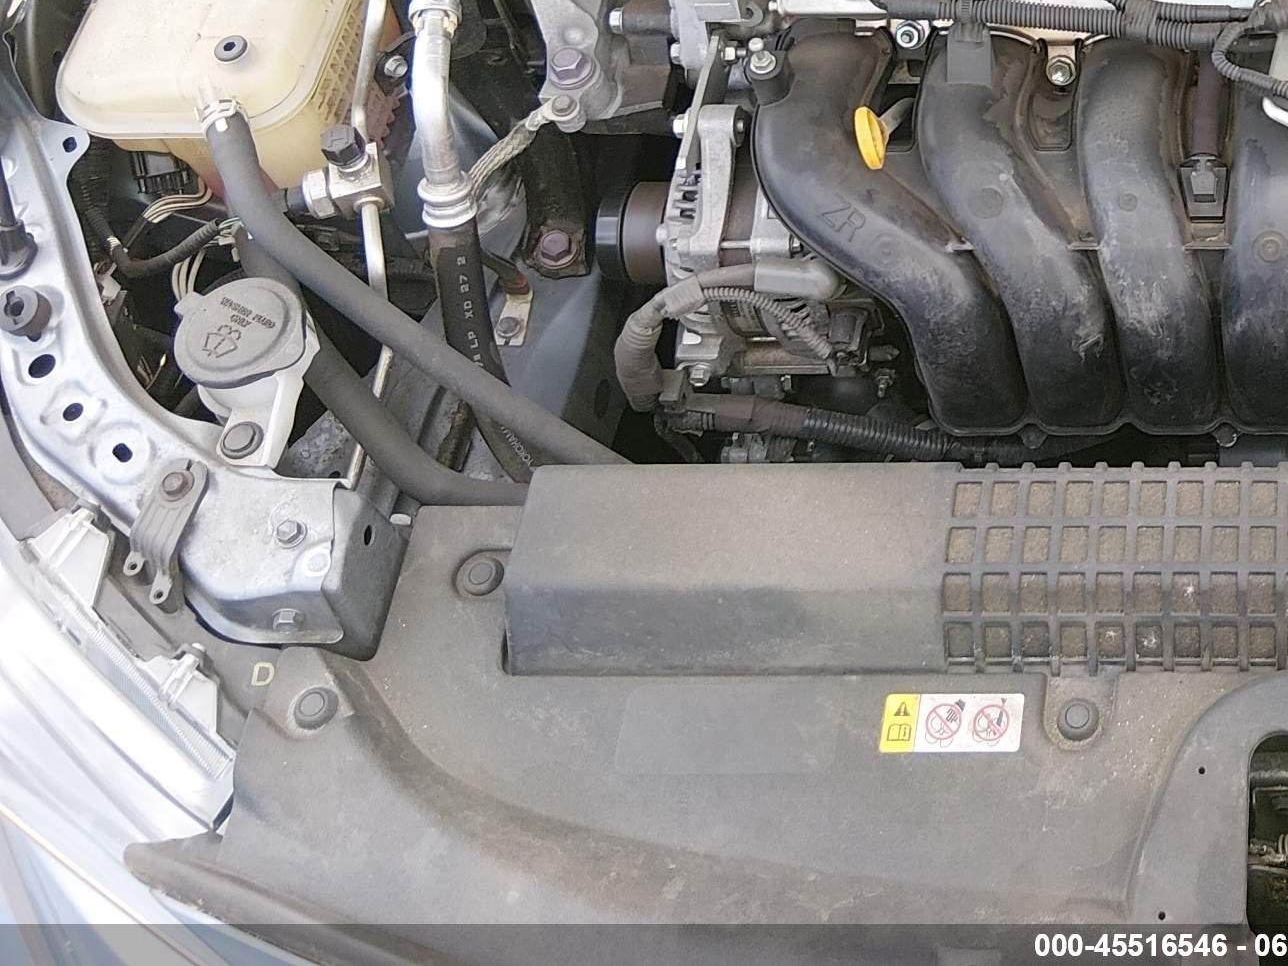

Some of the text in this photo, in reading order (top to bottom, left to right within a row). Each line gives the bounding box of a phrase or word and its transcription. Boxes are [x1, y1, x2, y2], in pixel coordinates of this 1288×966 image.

[459, 274, 470, 294] 27
[463, 300, 474, 319] XD
[467, 331, 479, 349] LP
[252, 662, 275, 686] D
